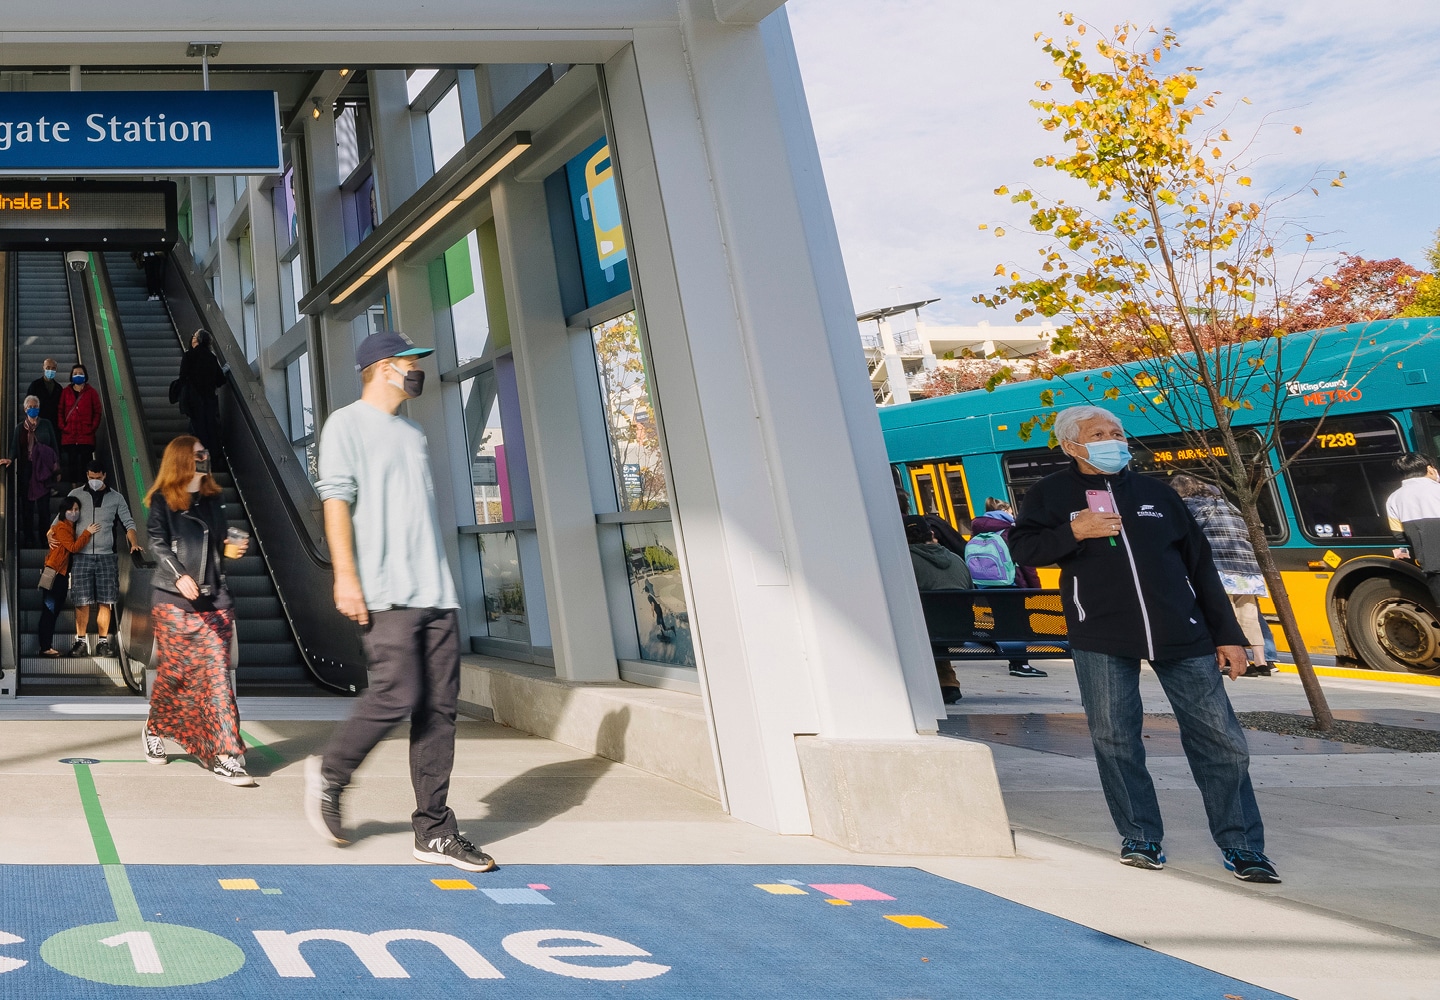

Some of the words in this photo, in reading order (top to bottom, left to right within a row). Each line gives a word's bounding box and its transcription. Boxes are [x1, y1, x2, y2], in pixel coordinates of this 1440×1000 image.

[86, 112, 212, 143] Station
[47, 192, 70, 210] Lk
[1300, 382, 1320, 392] King
[1319, 379, 1348, 389] County
[1303, 387, 1363, 407] METRO
[1316, 432, 1357, 449] 7238
